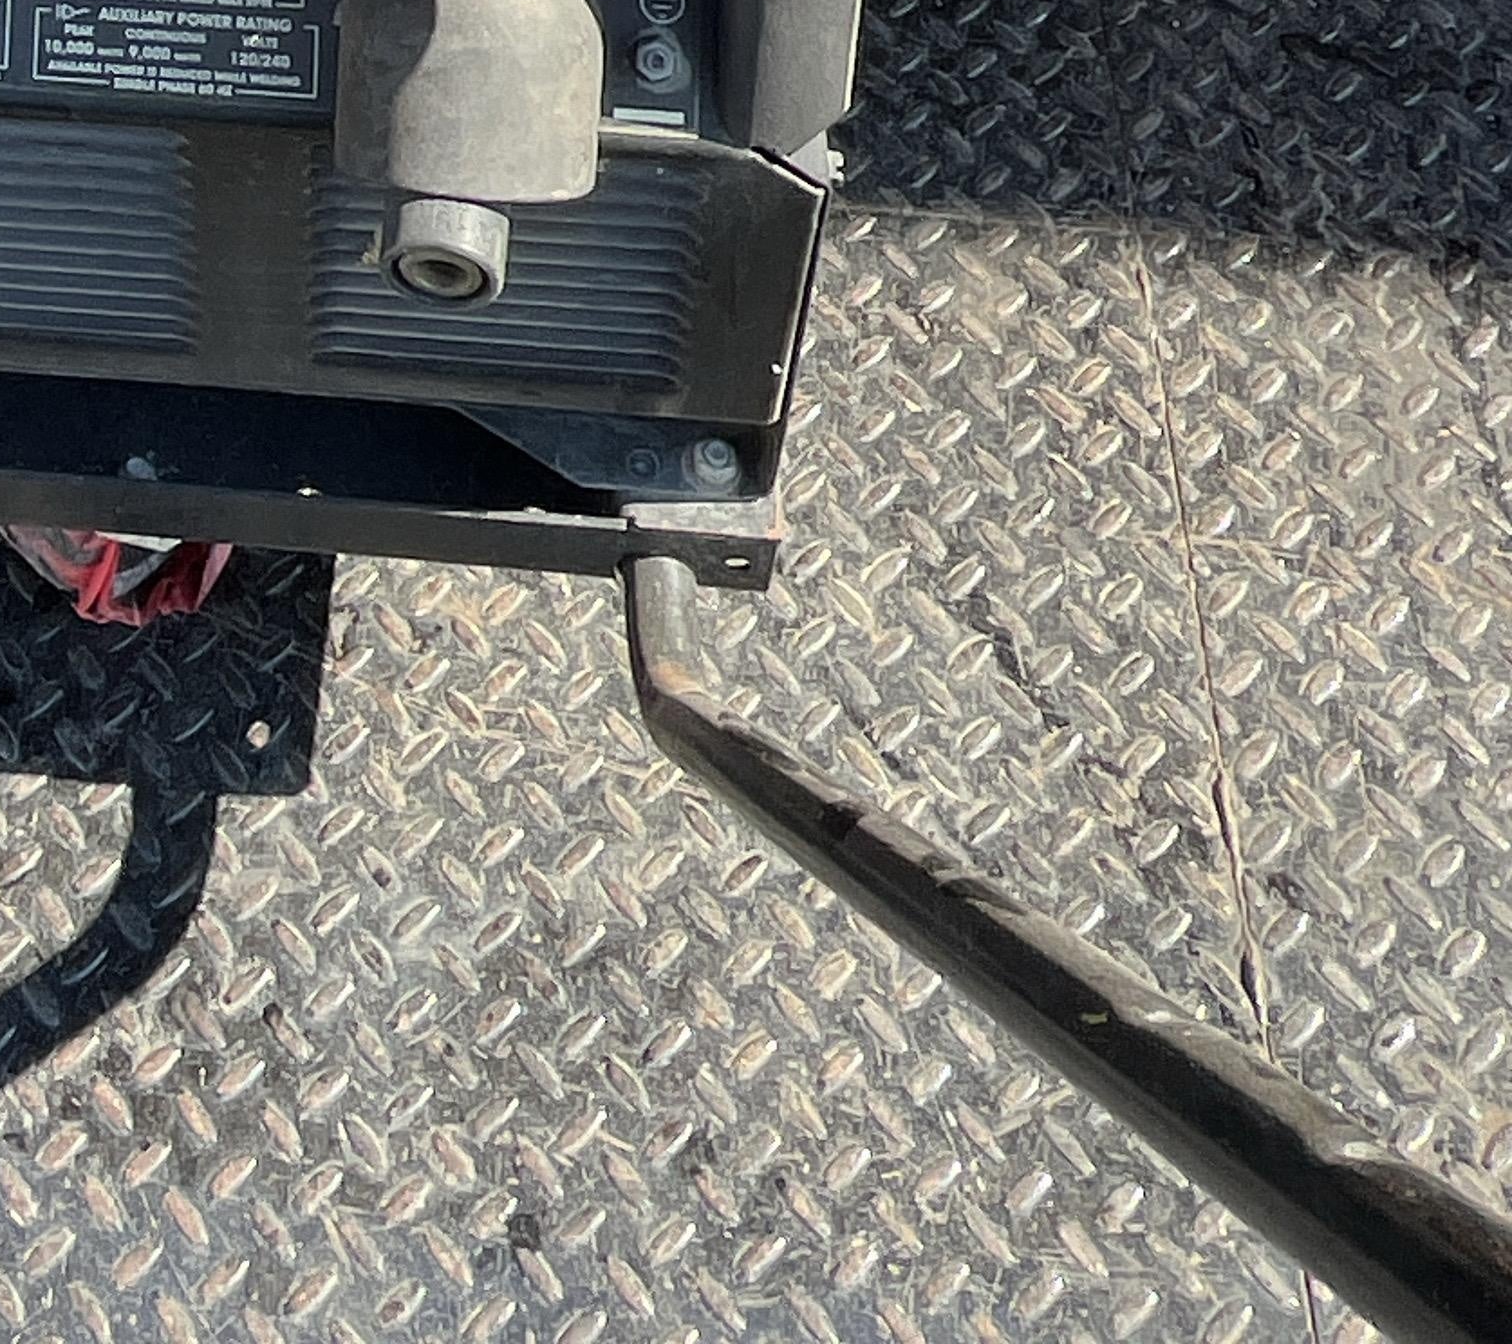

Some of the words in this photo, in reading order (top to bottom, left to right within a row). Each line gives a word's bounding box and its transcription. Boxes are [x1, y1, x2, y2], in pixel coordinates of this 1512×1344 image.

[98, 6, 174, 24] AUXILIARY
[177, 11, 231, 28] POWER
[236, 15, 291, 32] RATING
